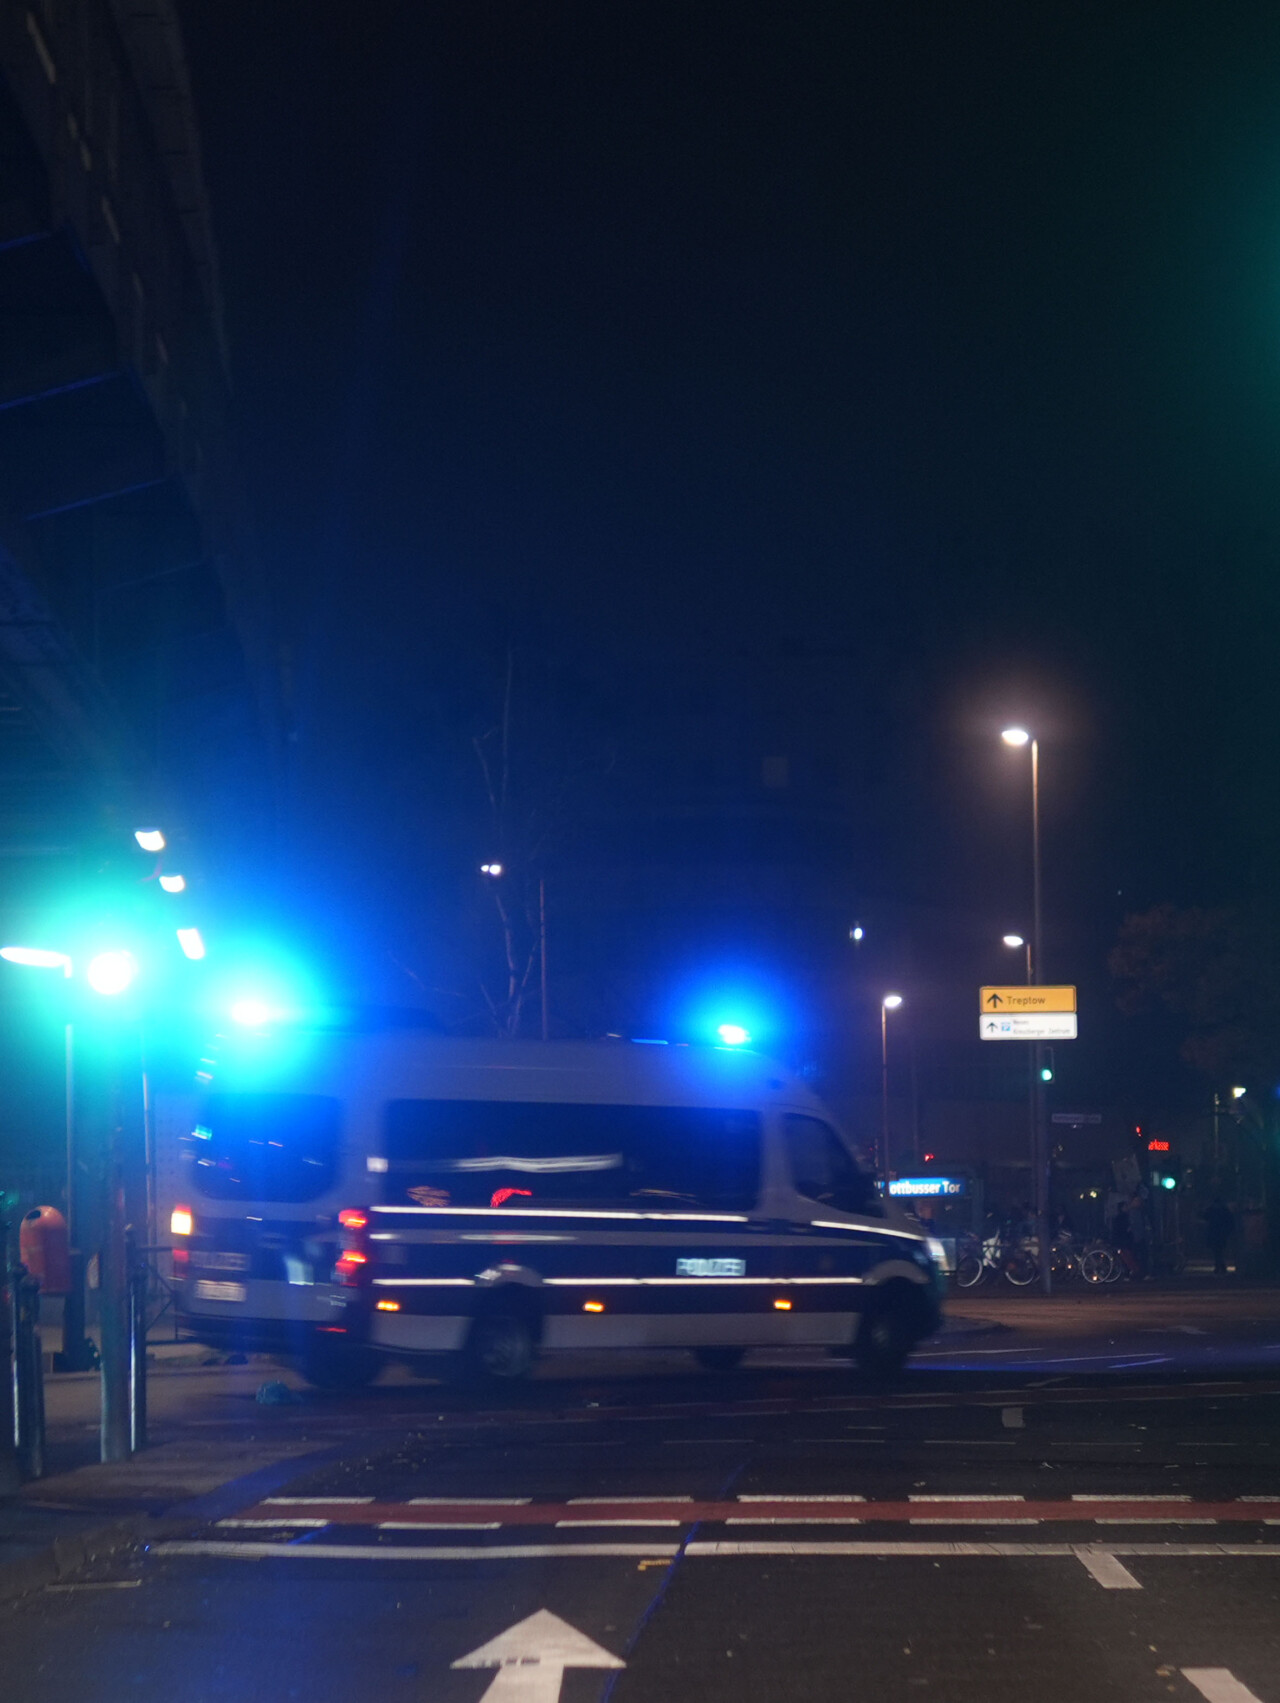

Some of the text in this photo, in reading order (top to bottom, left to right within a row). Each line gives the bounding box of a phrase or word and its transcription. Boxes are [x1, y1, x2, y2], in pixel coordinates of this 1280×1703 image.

[1006, 996, 1046, 1006] Treptow
[1148, 1139, 1170, 1151] arkasse
[889, 1180, 961, 1195] ottbusser Tor
